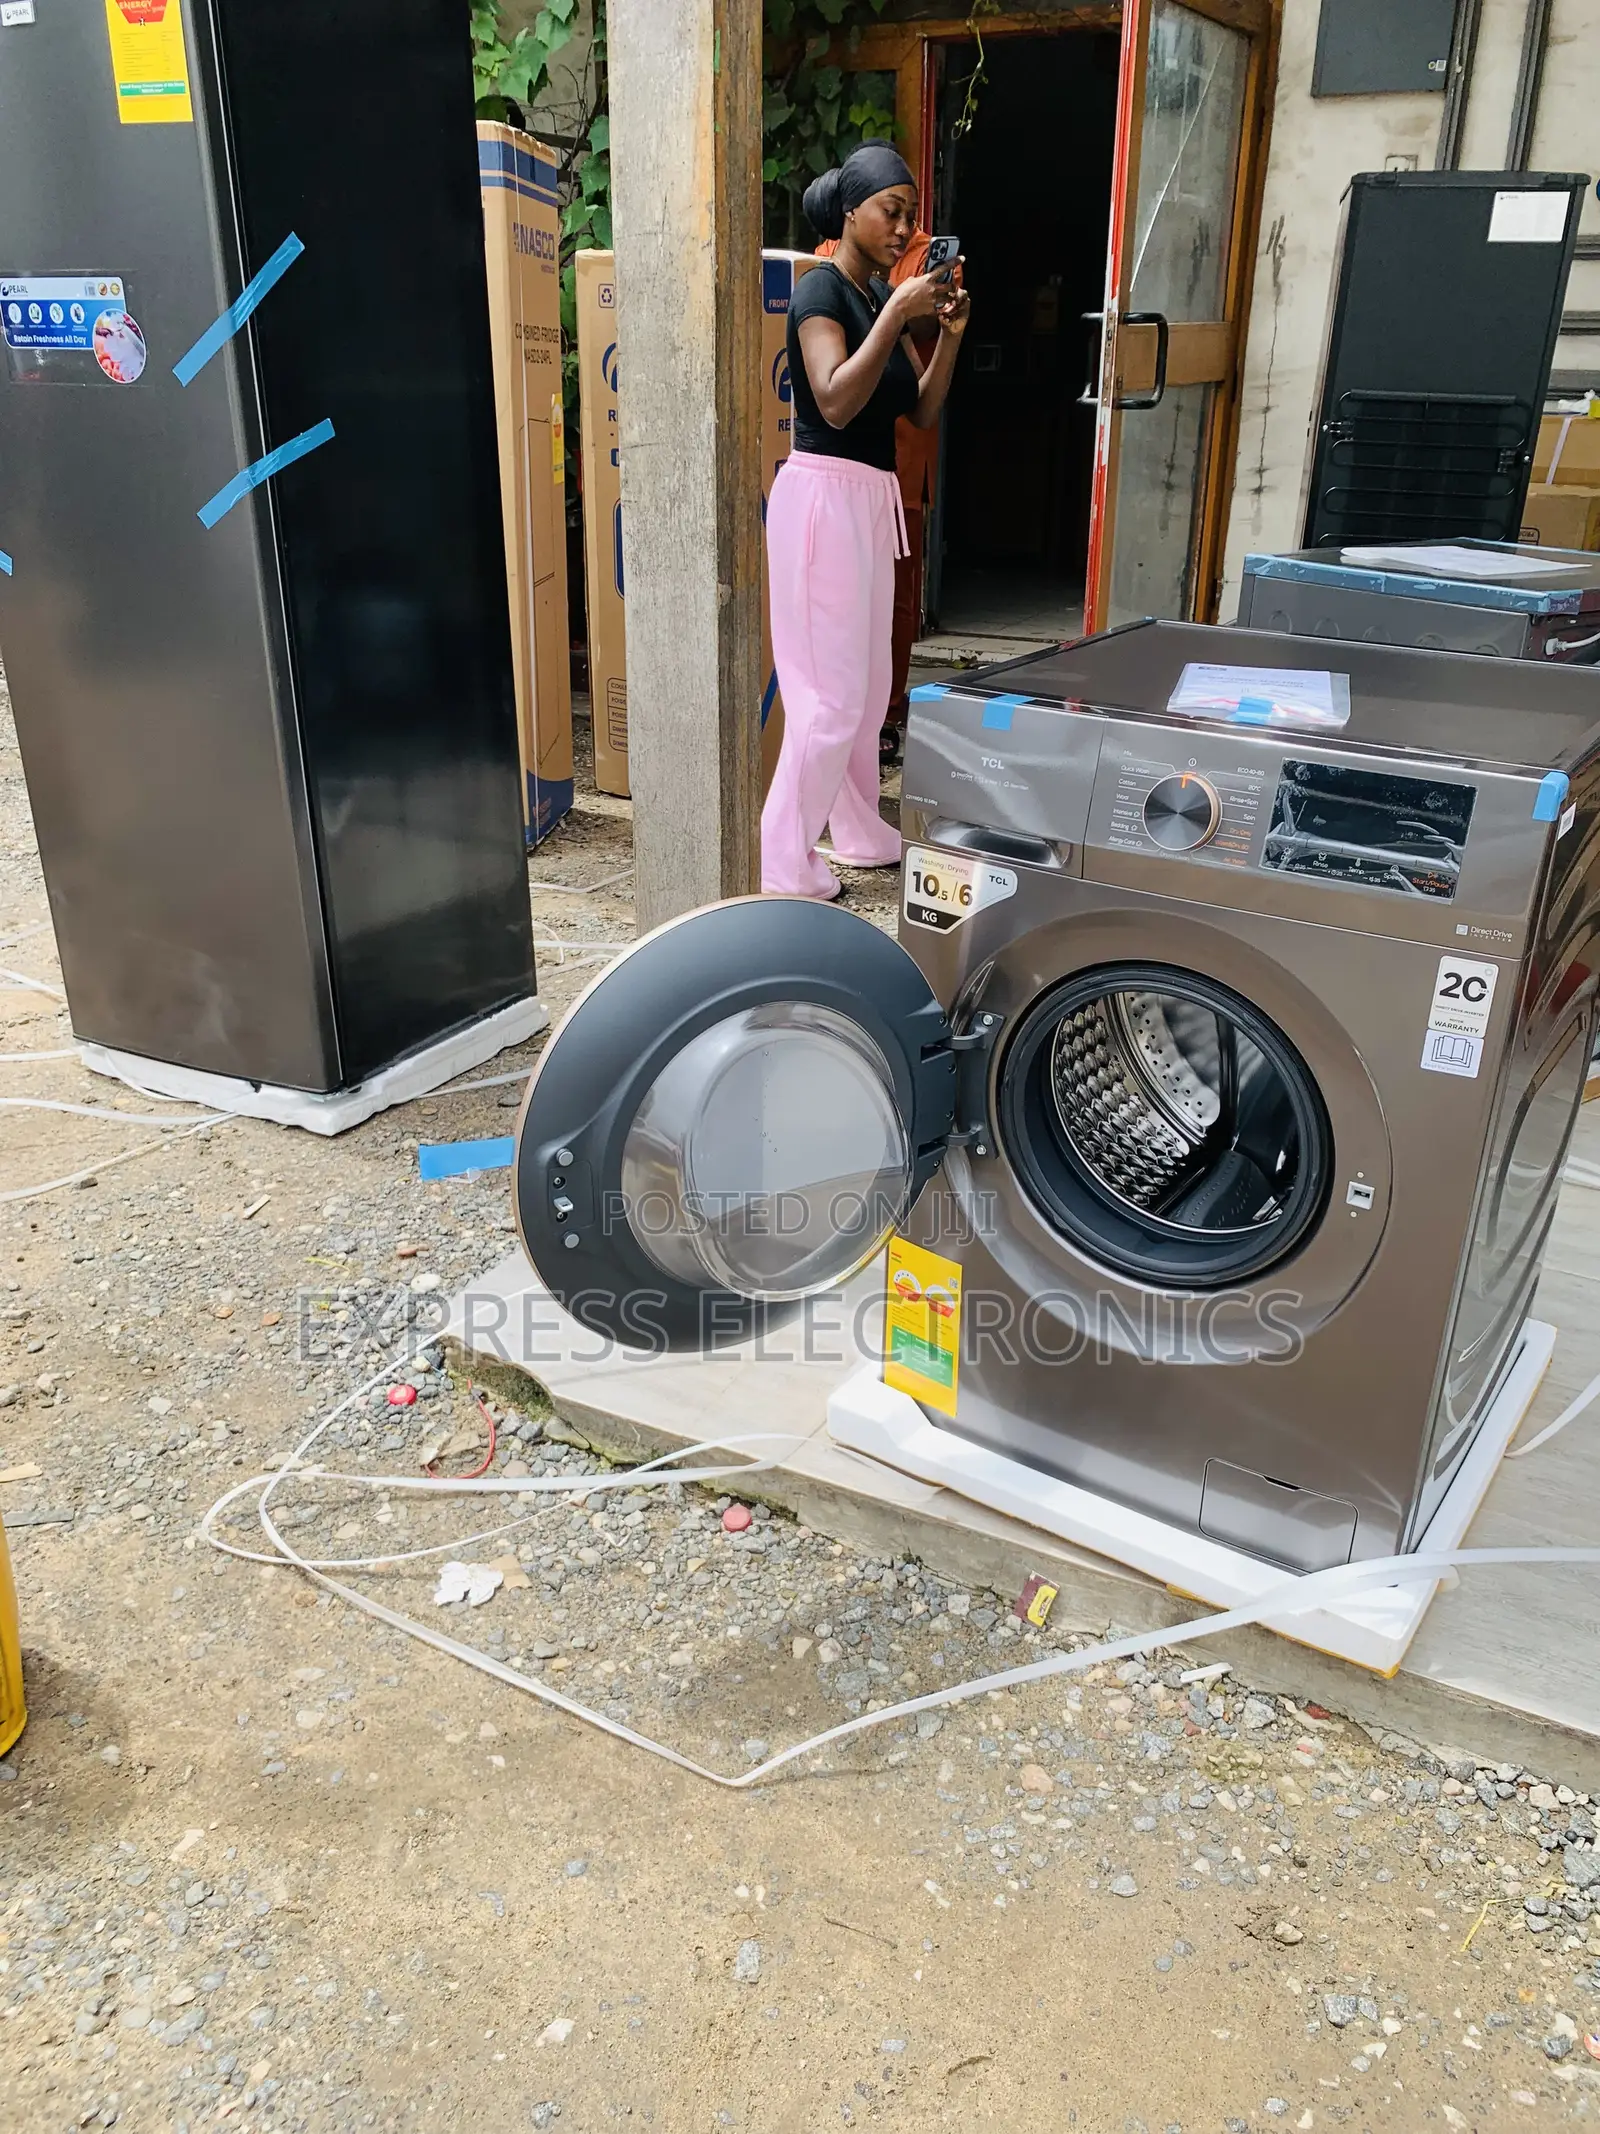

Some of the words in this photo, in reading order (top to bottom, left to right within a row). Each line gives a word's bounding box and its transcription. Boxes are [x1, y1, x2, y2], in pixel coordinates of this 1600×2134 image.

[119, 0, 152, 10] ENERGY
[12, 8, 30, 17] PEARL
[520, 223, 555, 262] NASCO
[8, 284, 29, 294] PEARL
[13, 334, 33, 343] Retain
[33, 334, 64, 344] Freshness
[65, 334, 73, 343] All
[74, 335, 87, 346] Day
[981, 756, 1005, 770] TCL
[1120, 764, 1135, 773] Quick
[1135, 766, 1150, 775] Wash
[1118, 778, 1137, 787] Cotton
[1112, 808, 1133, 817] Intensive
[1243, 813, 1256, 821] Spin
[1110, 821, 1129, 831] Bedding
[917, 856, 945, 870] Washing
[947, 864, 969, 876] Drying
[1312, 860, 1329, 869] Rinse
[988, 874, 1008, 886] TCL
[921, 909, 938, 923] KG
[1470, 926, 1492, 936] Direct
[1493, 929, 1512, 939] Drive
[1434, 1020, 1479, 1034] WARRANTY
